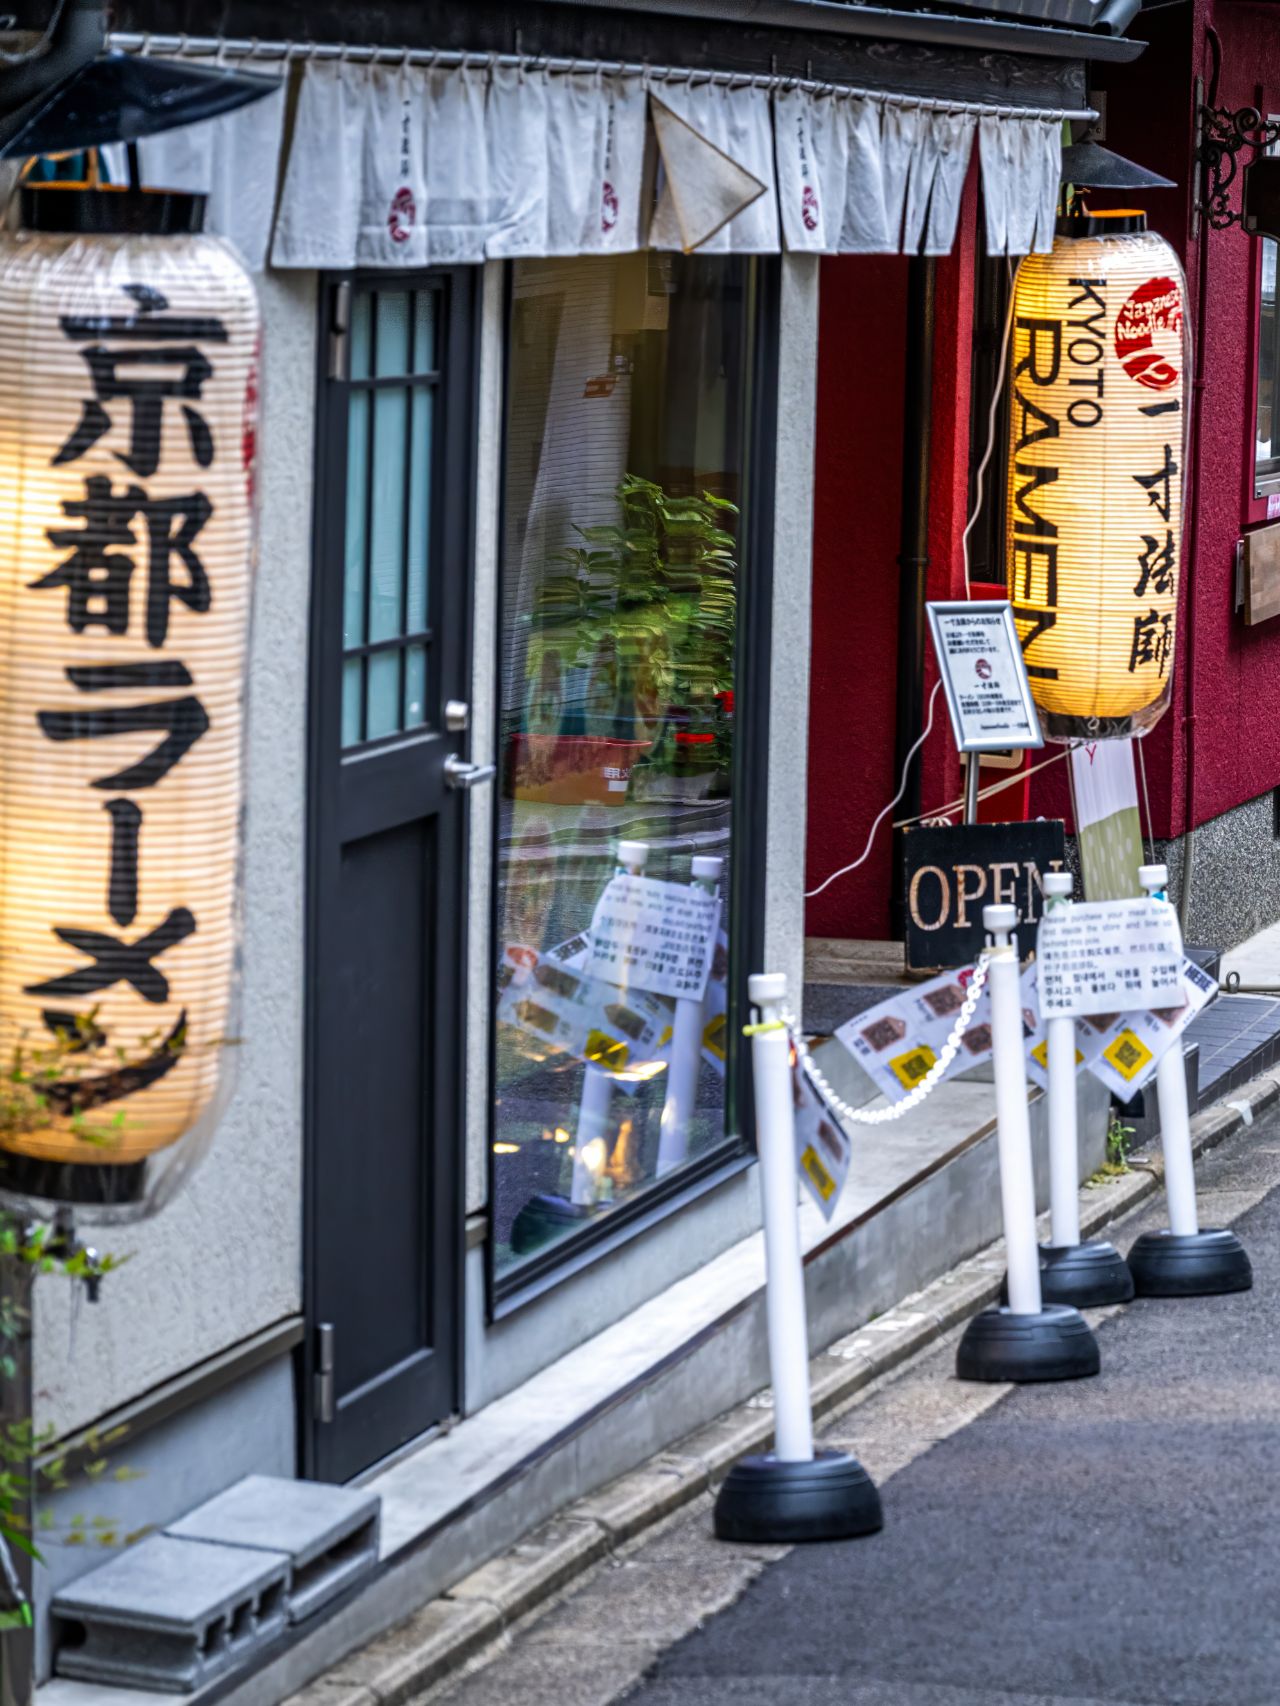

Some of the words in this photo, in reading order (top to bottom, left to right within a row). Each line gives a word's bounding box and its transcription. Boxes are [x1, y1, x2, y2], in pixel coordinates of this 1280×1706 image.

[1067, 278, 1107, 428] KYOTO
[1129, 399, 1180, 679] 一寸法師
[22, 282, 230, 1116] 京都ラーメン
